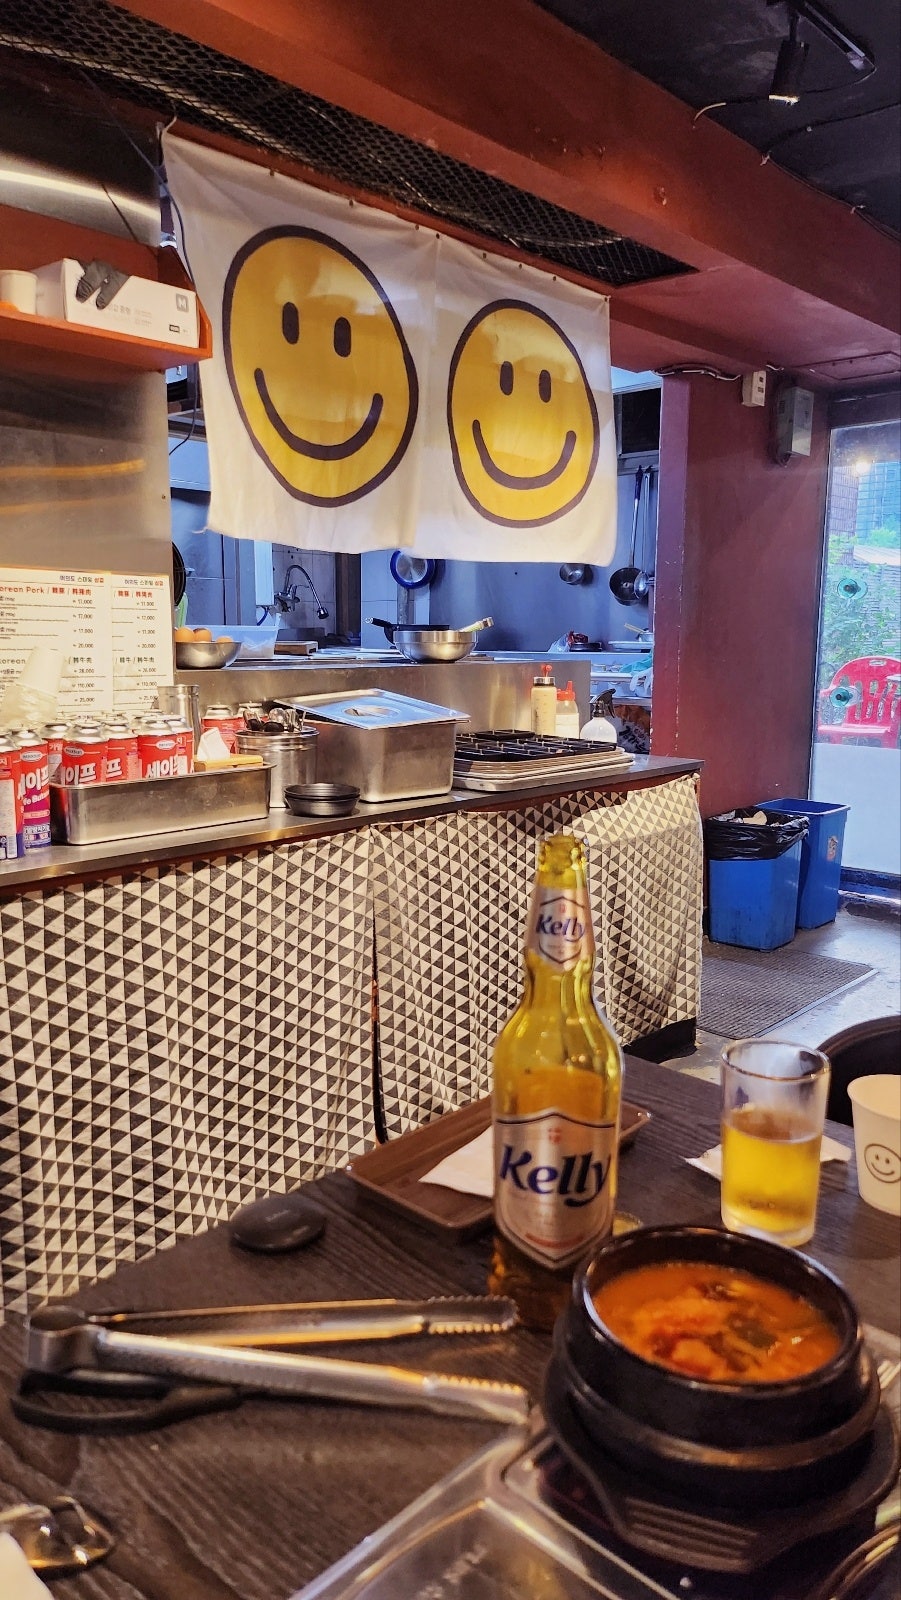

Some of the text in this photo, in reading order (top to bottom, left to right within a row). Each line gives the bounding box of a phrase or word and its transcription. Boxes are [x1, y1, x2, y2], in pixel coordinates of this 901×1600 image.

[26, 586, 45, 594] Pork
[535, 913, 586, 942] Kelly
[500, 1144, 612, 1208] Kelly
